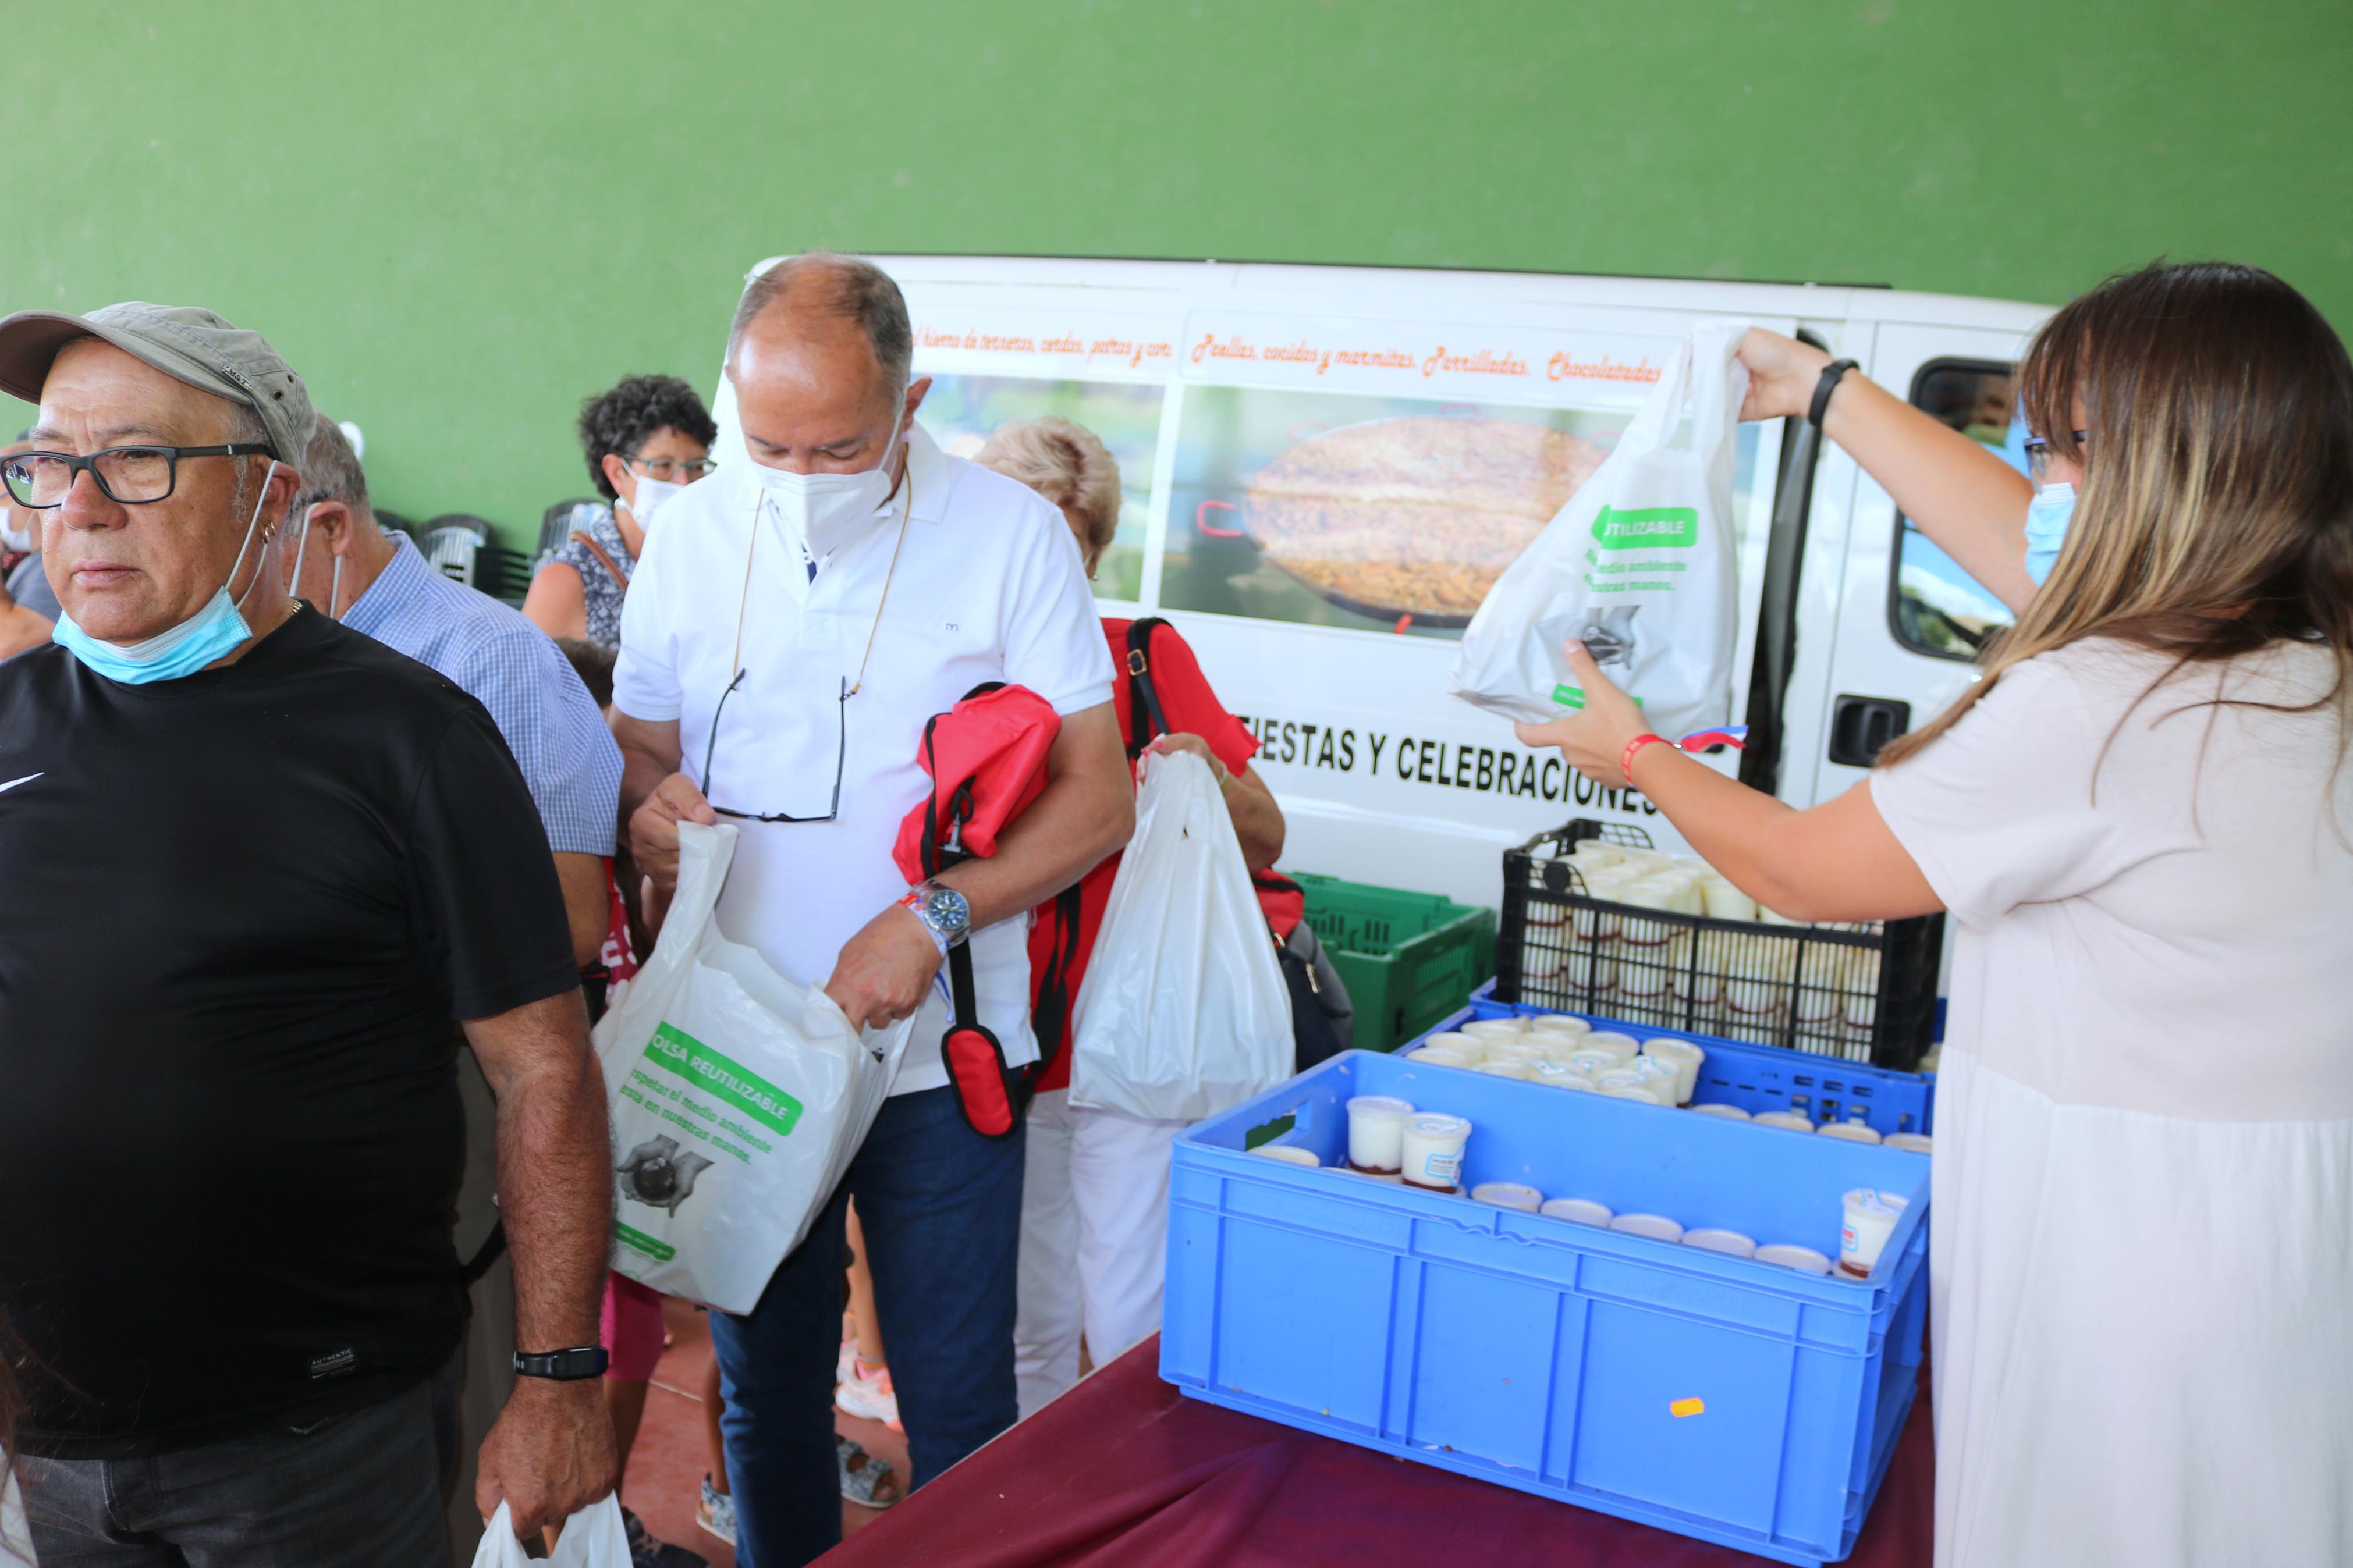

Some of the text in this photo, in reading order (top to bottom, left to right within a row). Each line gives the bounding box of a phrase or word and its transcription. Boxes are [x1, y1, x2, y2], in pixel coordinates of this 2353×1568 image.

[963, 327, 978, 349] de
[1130, 342, 1143, 368] y
[1316, 350, 1332, 375] y
[1369, 733, 1386, 776] Y
[689, 1055, 789, 1121] REUTILIZABLE
[645, 1100, 661, 1115] en
[661, 1108, 710, 1141] nuestras
[669, 1090, 683, 1102] el
[681, 1097, 718, 1123] medio
[718, 1118, 773, 1154] ambiente
[312, 1349, 352, 1365] AUTHENTIC
